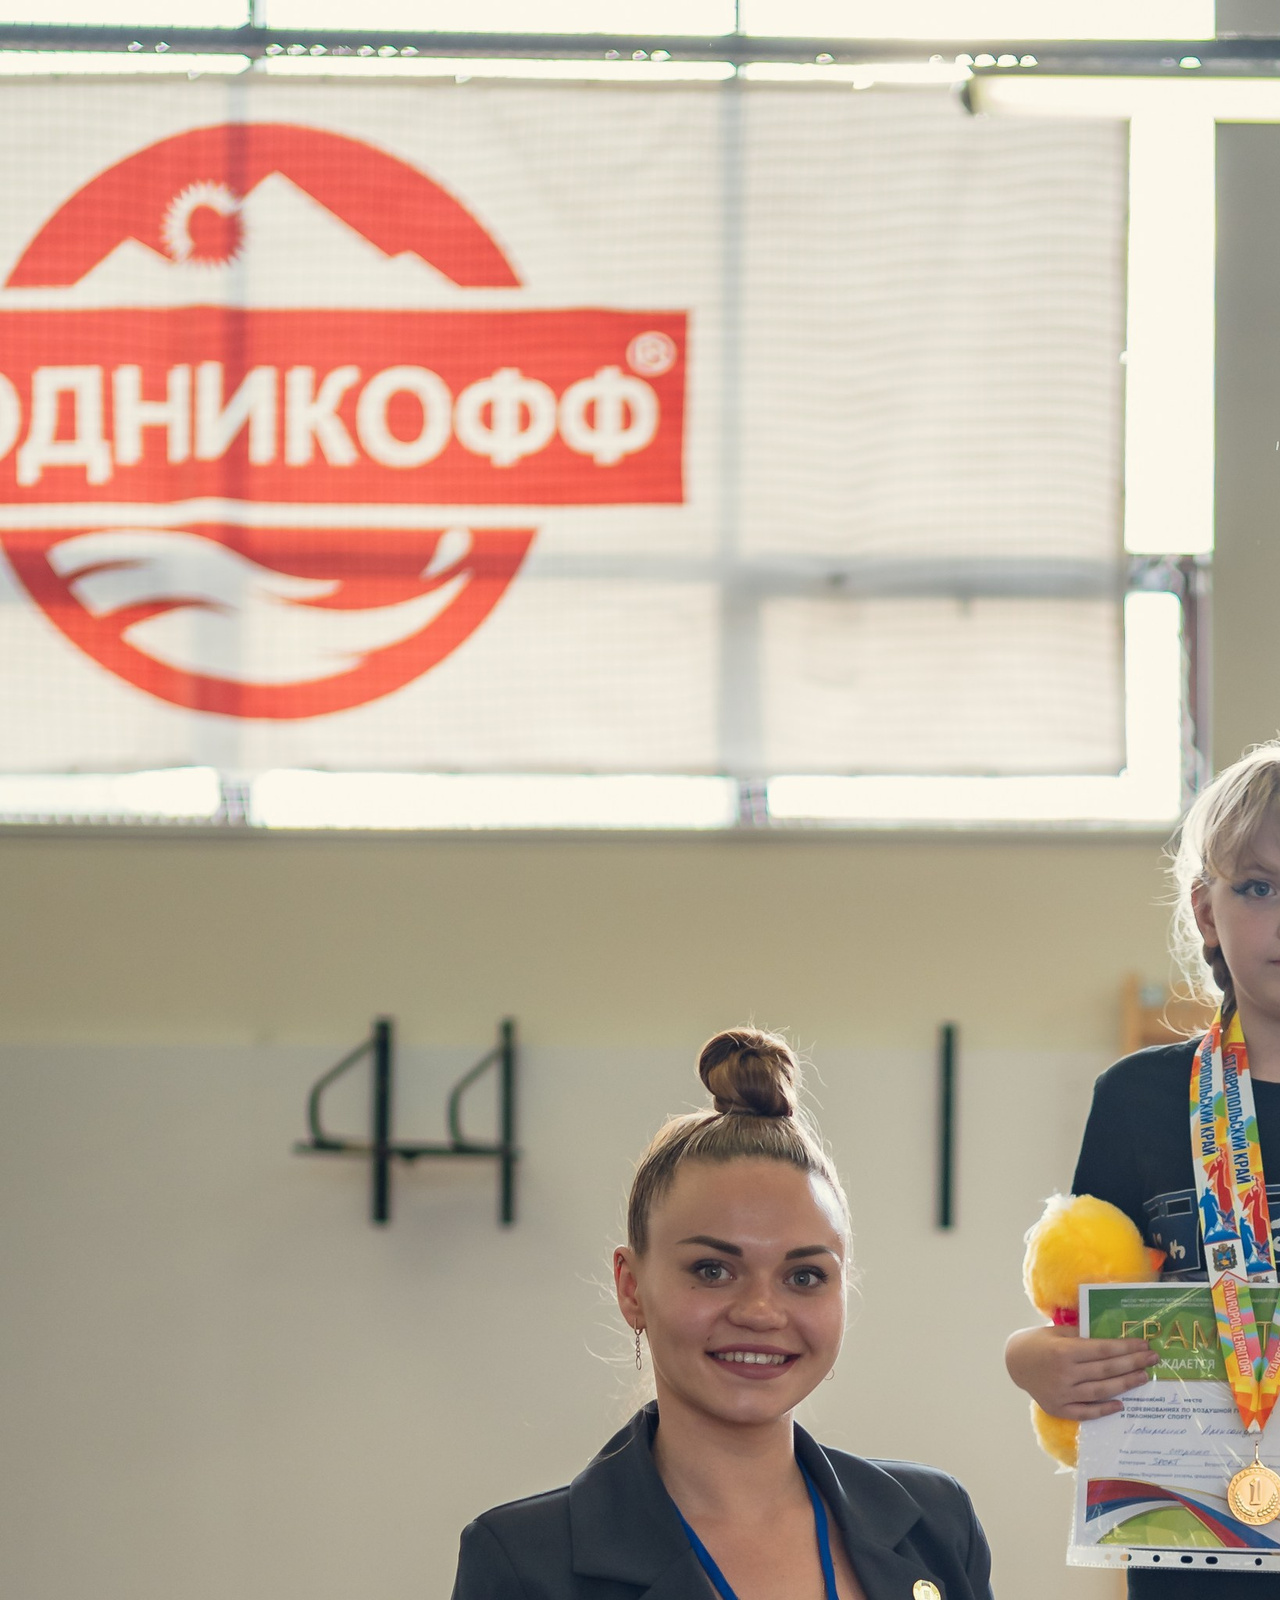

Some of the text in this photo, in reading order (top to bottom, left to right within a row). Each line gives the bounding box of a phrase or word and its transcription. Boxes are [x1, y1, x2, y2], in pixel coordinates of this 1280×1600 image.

[1200, 1126, 1219, 1157] КРАЙ
[1223, 1054, 1255, 1186] СТАВРОПОЛЬСКИЙ КРАЙ
[1223, 1279, 1252, 1377] STAVROPOL TERRITORY
